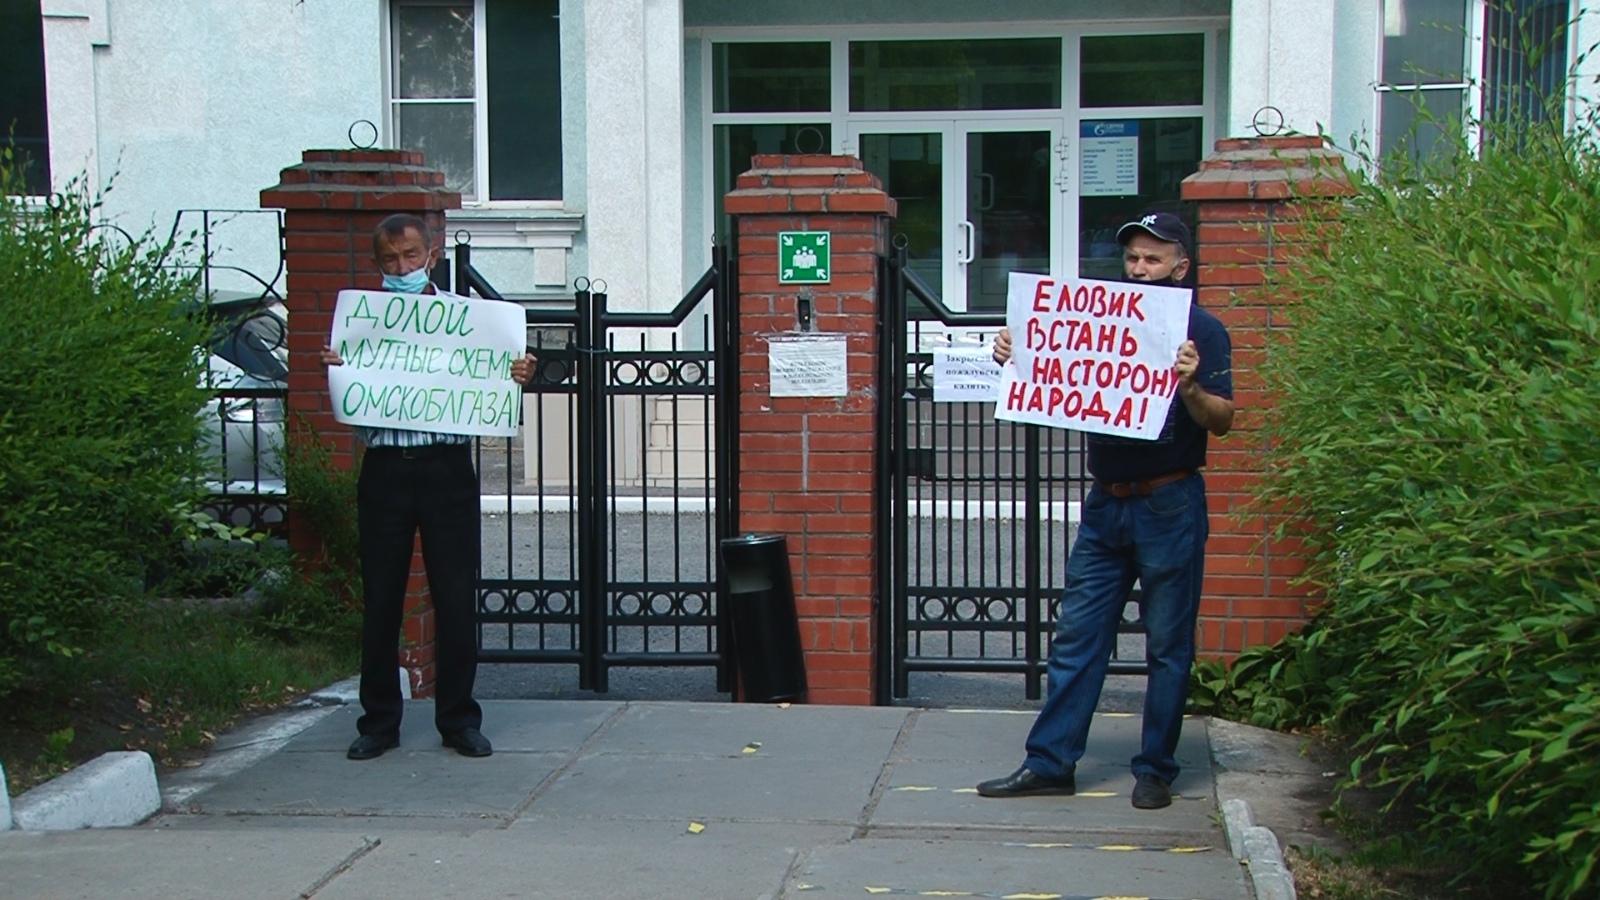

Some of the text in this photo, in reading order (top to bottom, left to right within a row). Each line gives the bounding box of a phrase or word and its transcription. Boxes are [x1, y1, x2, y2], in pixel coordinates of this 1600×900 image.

[346, 294, 473, 336] ДОЛОЙ
[1033, 280, 1145, 322] ЕЛОВИК
[1027, 317, 1137, 357] ВСТАНЬ
[342, 381, 521, 429] ОМСКОБЛГАЗА!
[1007, 381, 1149, 430] НАРОДА!
